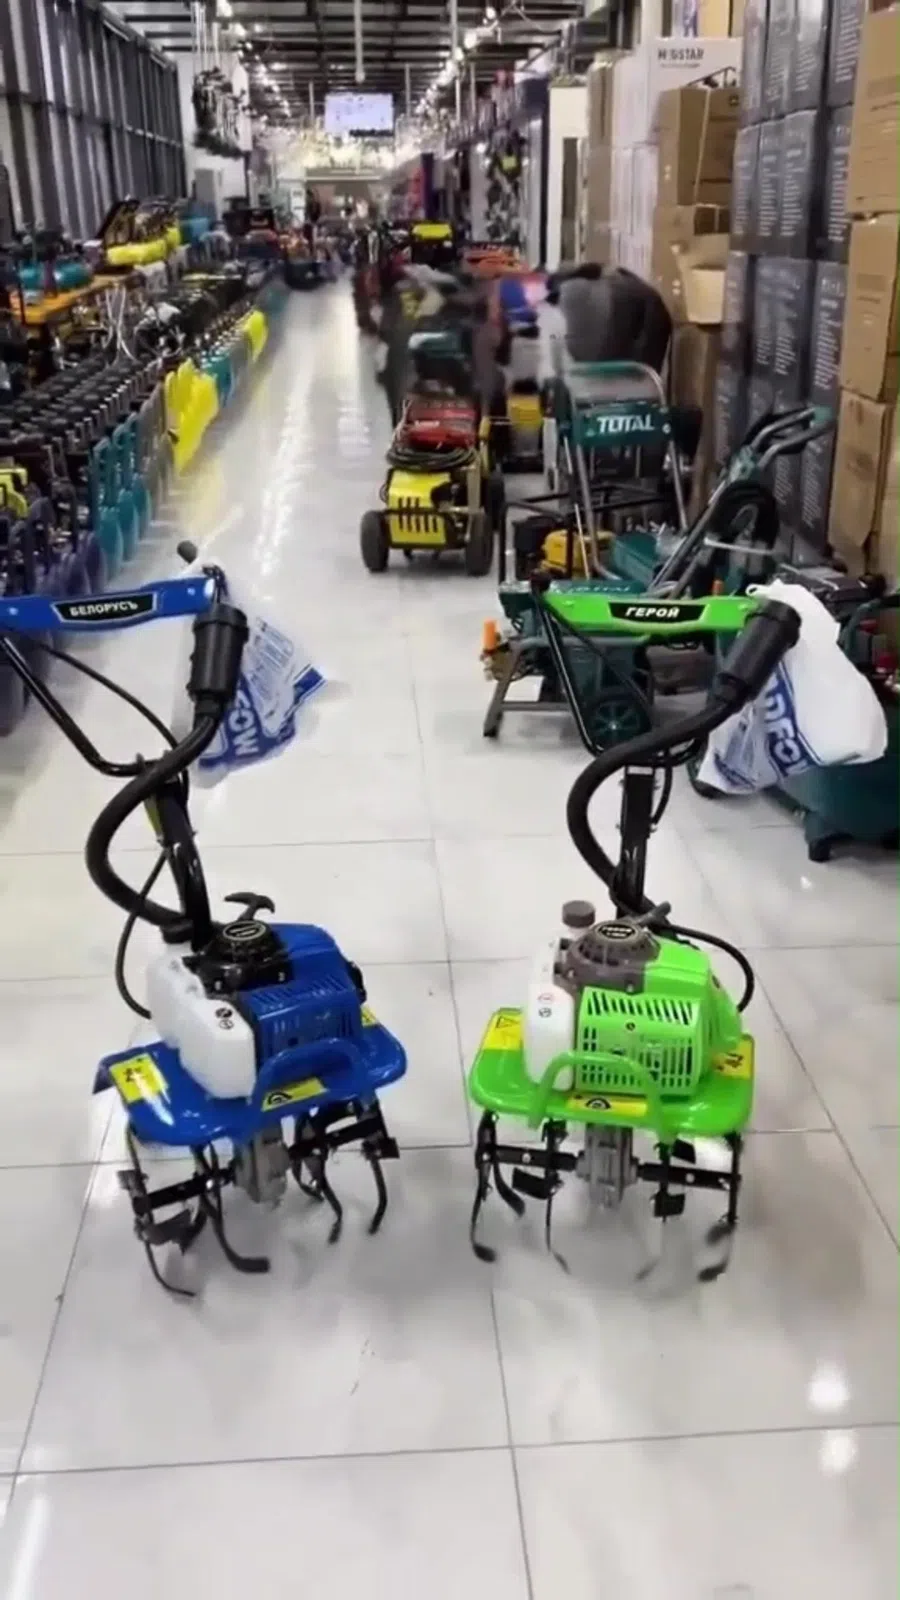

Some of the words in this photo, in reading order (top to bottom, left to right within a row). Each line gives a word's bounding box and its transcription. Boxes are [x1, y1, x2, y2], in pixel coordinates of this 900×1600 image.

[596, 414, 655, 434] TOTAL
[69, 601, 138, 617] БЕЛОРУСЪ
[625, 606, 680, 618] ГЕРОЙ
